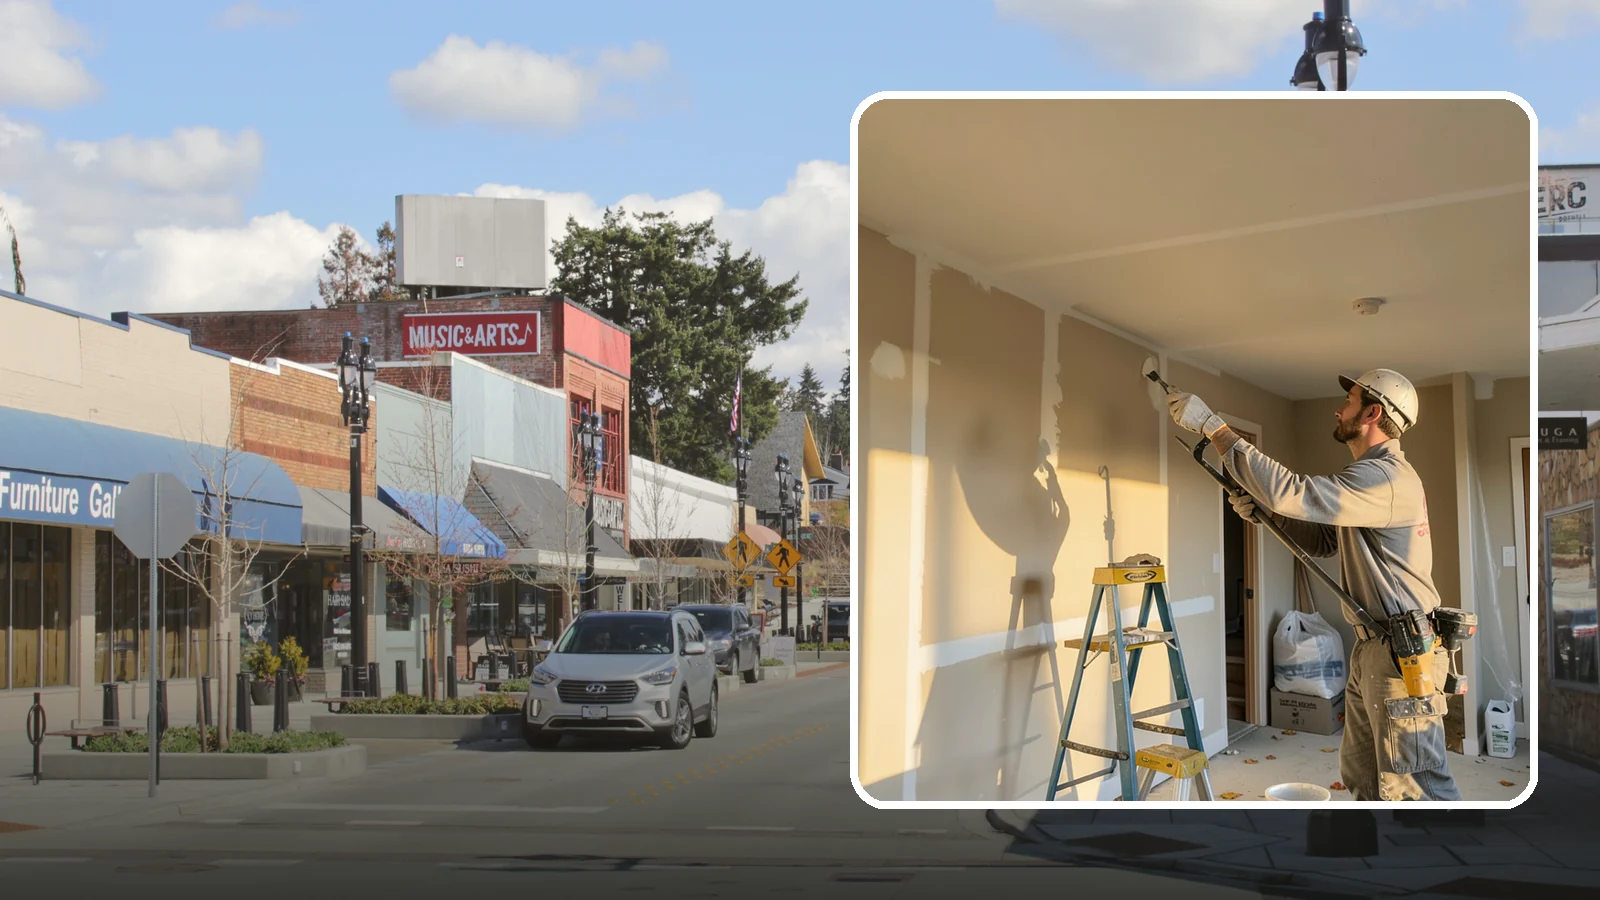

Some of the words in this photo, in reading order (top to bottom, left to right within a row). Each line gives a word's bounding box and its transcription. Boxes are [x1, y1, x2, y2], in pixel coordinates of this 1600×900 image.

[0, 471, 79, 515] Furniture
[89, 482, 122, 519] Gal
[453, 563, 479, 574] SUSHI
